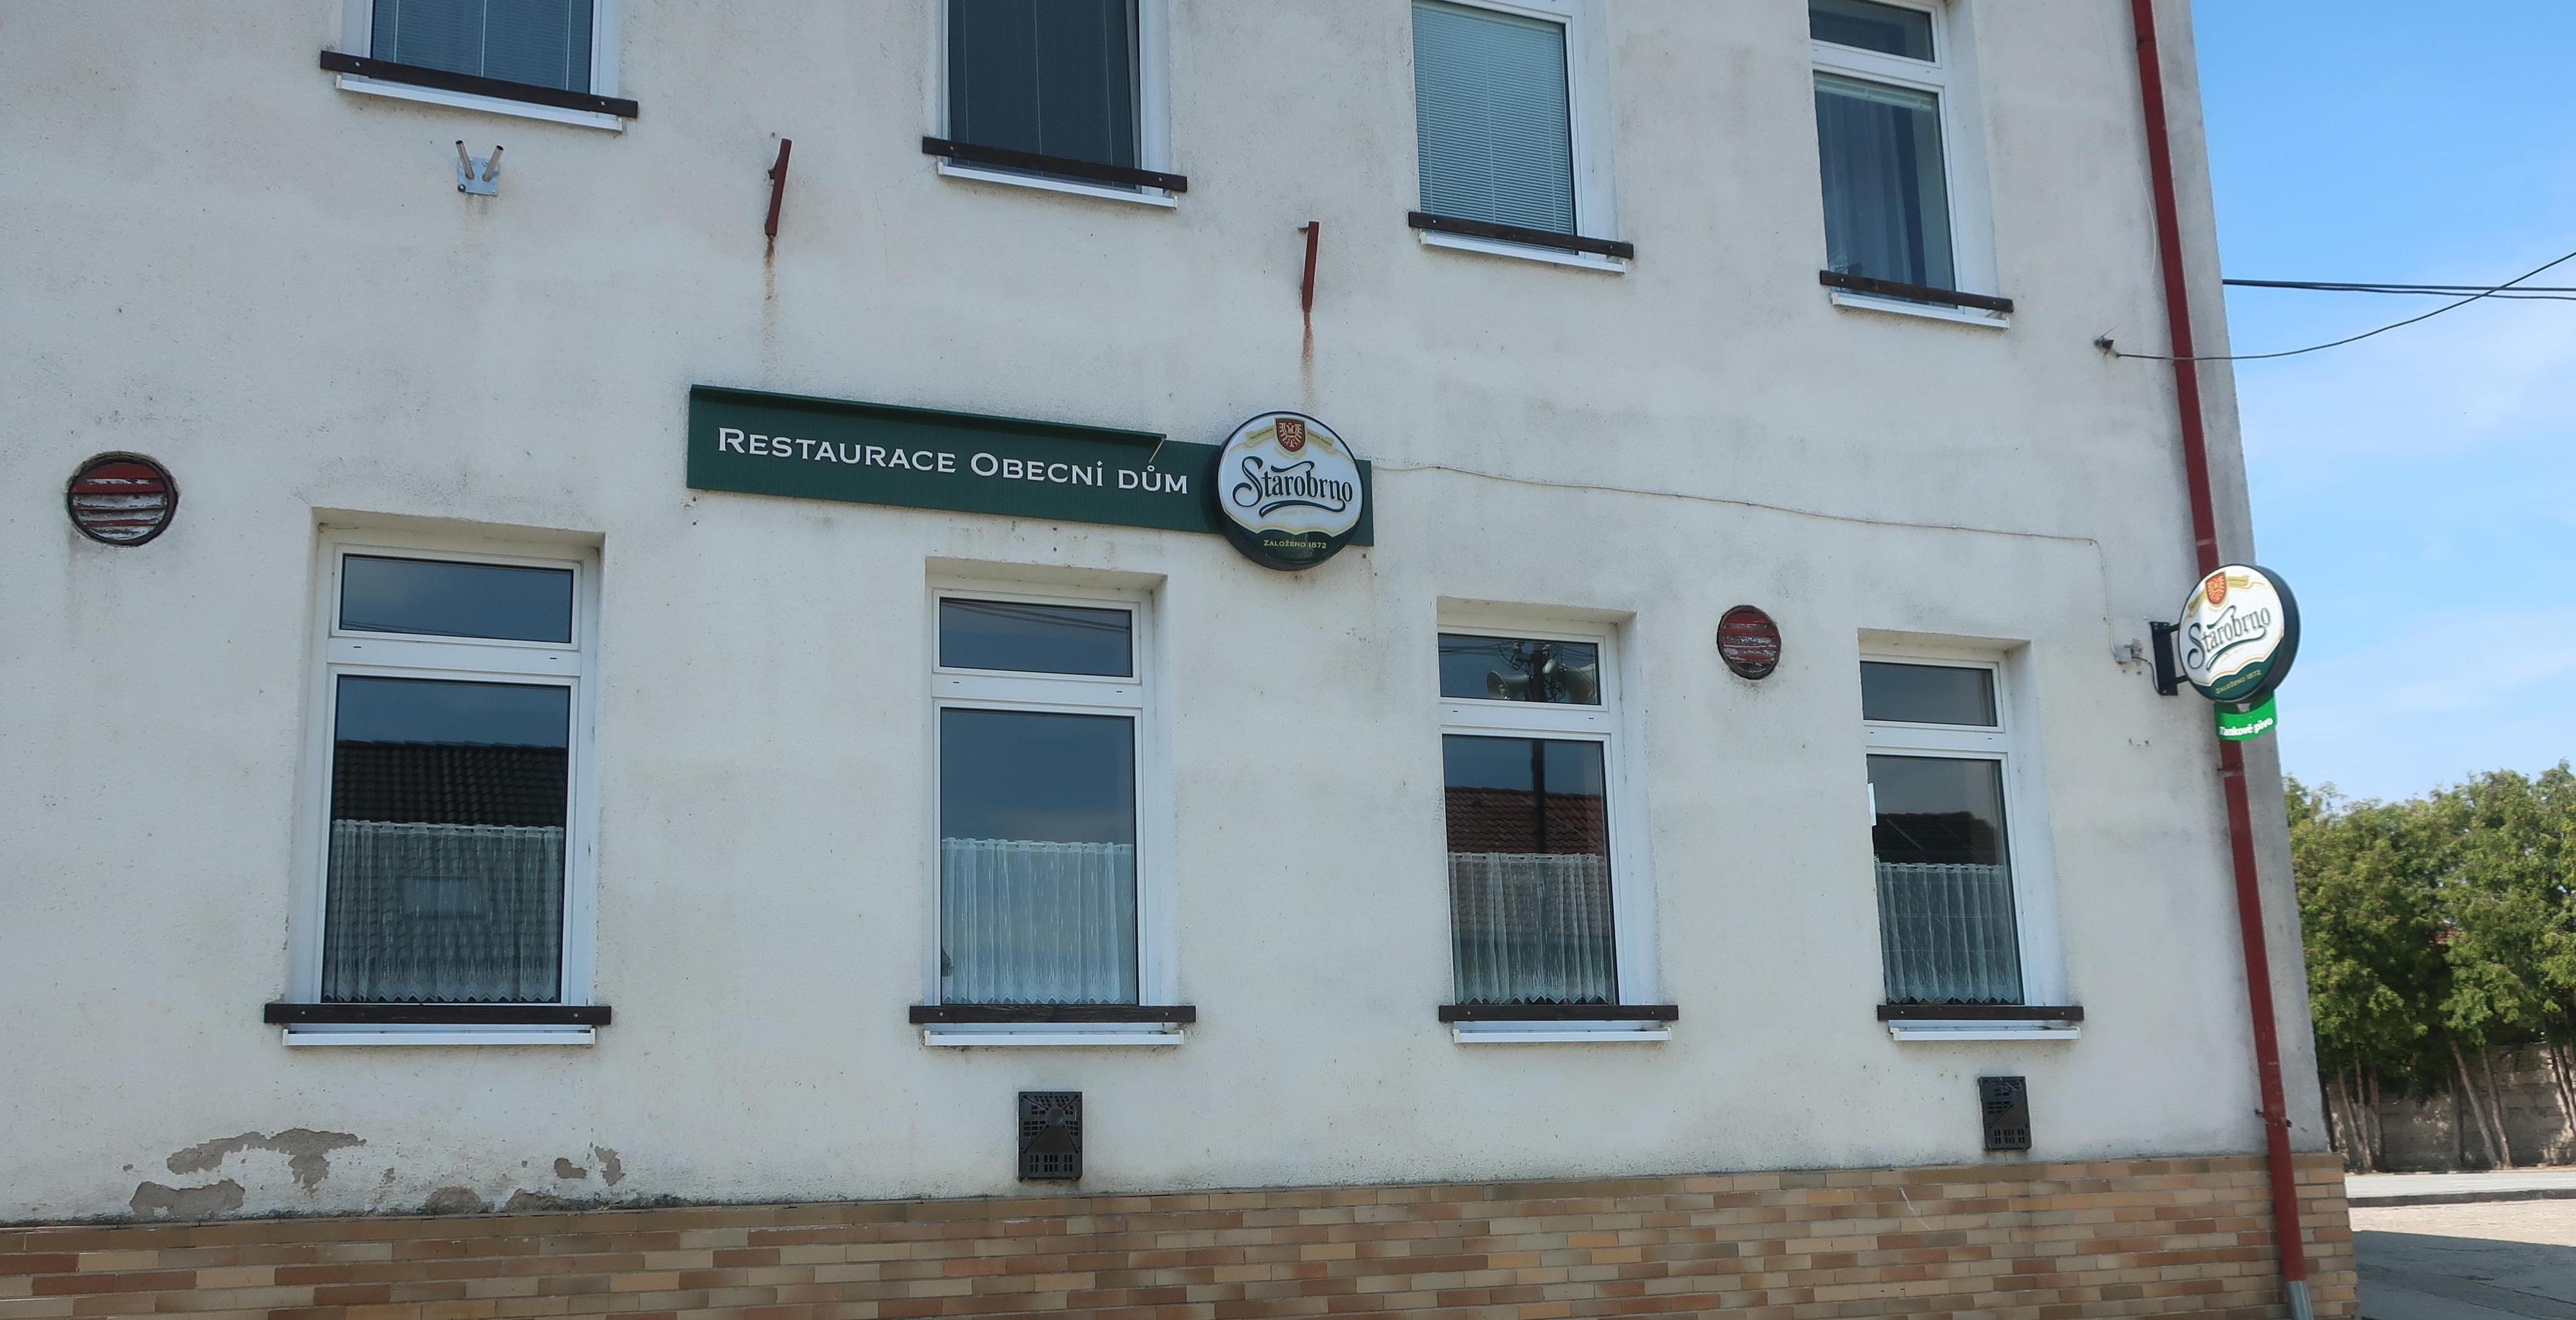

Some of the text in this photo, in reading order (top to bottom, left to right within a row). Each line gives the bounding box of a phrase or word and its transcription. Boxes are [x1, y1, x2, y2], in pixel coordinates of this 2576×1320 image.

[717, 427, 957, 473] RESTAURACE
[1233, 456, 1352, 517] Starobrno
[1264, 539, 1327, 549] ZALOŽENO 1872
[2187, 606, 2271, 671] Starobrno
[2219, 717, 2273, 736] Tankové pivo
